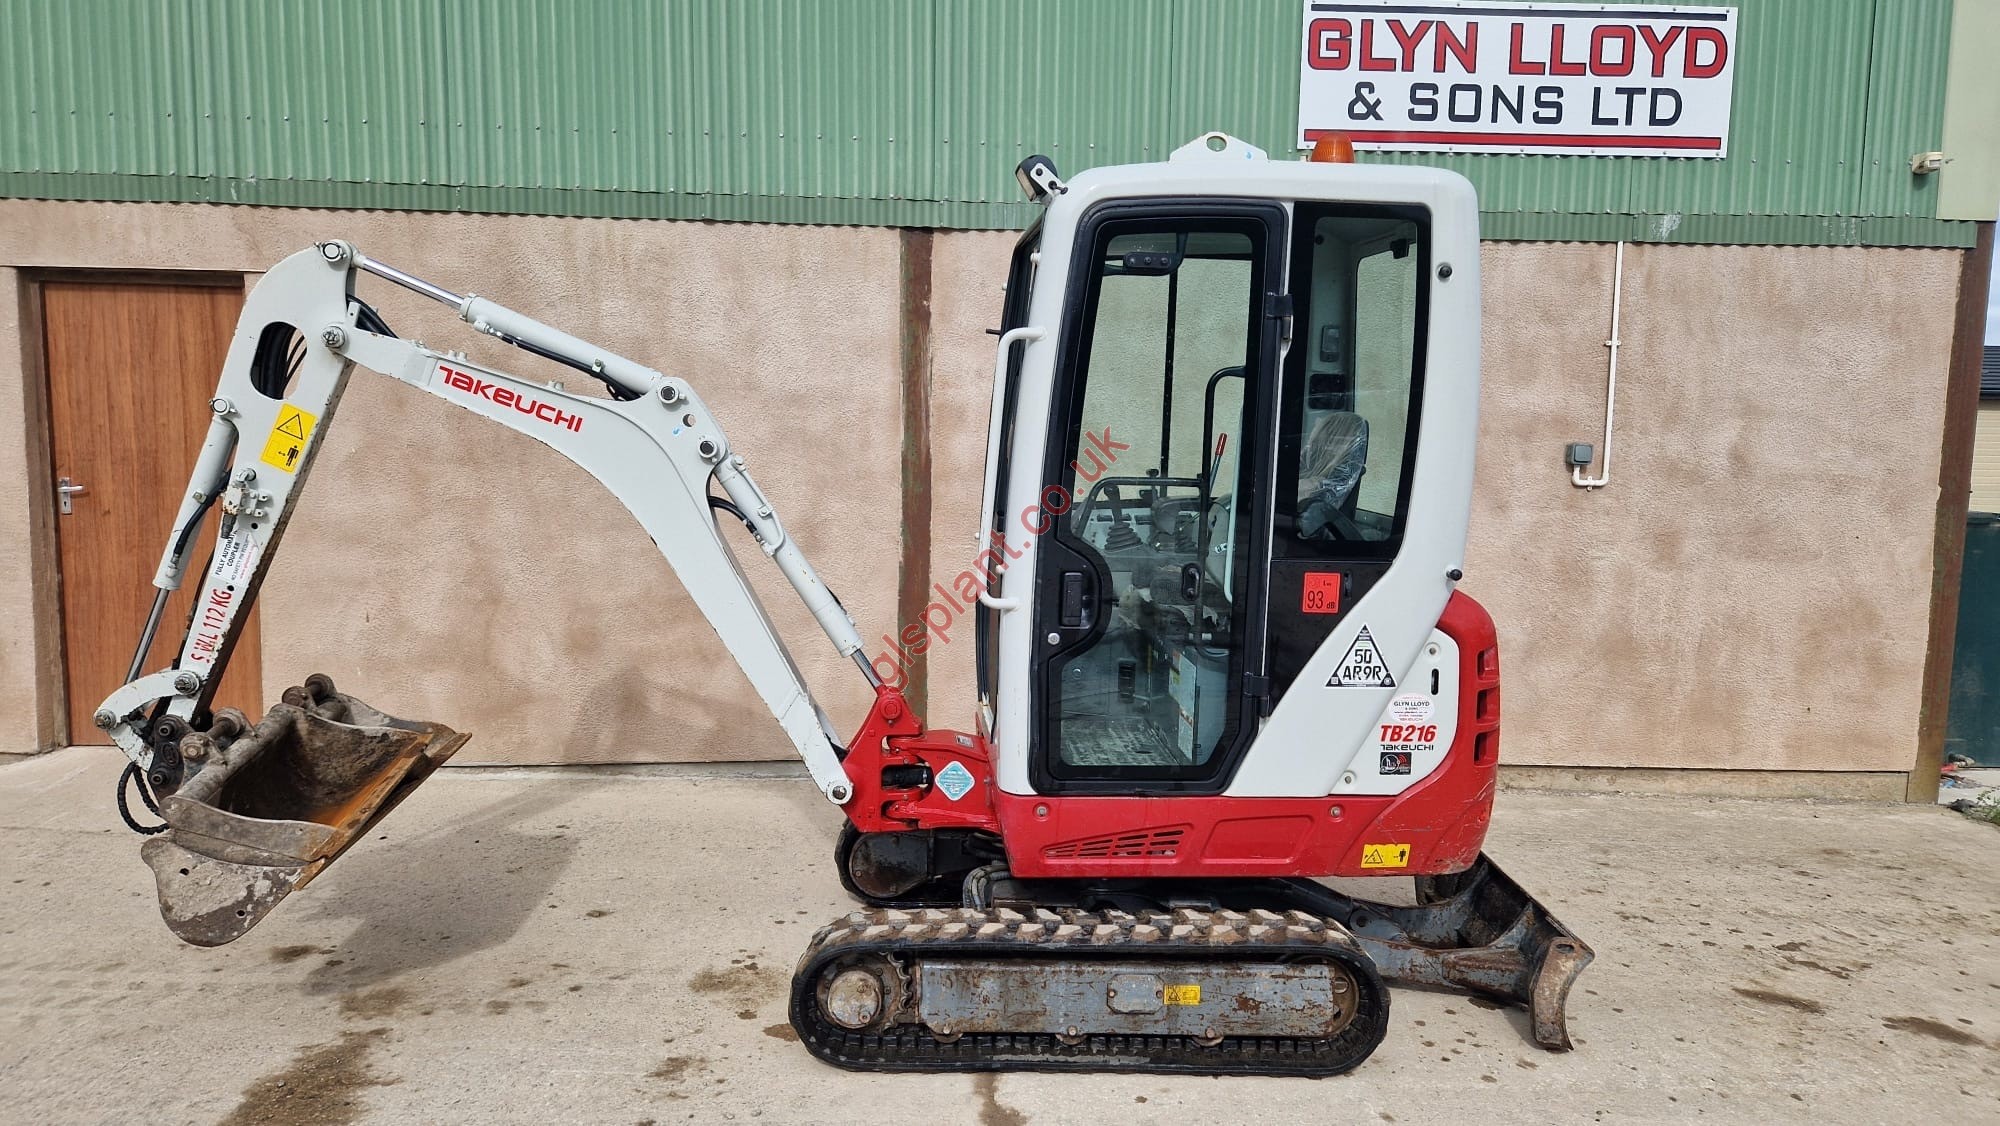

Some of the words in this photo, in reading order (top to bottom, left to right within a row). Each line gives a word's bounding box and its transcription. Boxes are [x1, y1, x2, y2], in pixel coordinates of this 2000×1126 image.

[1308, 17, 1479, 74] GLYN
[1508, 22, 1729, 79] LLOYD
[1347, 81, 1384, 122] &
[1407, 82, 1564, 125] SONS
[1591, 86, 1683, 127] LTD
[227, 542, 241, 567] COUPLER
[1307, 590, 1324, 609] 93
[1343, 665, 1382, 681] AR9R
[1380, 724, 1437, 742] TB216
